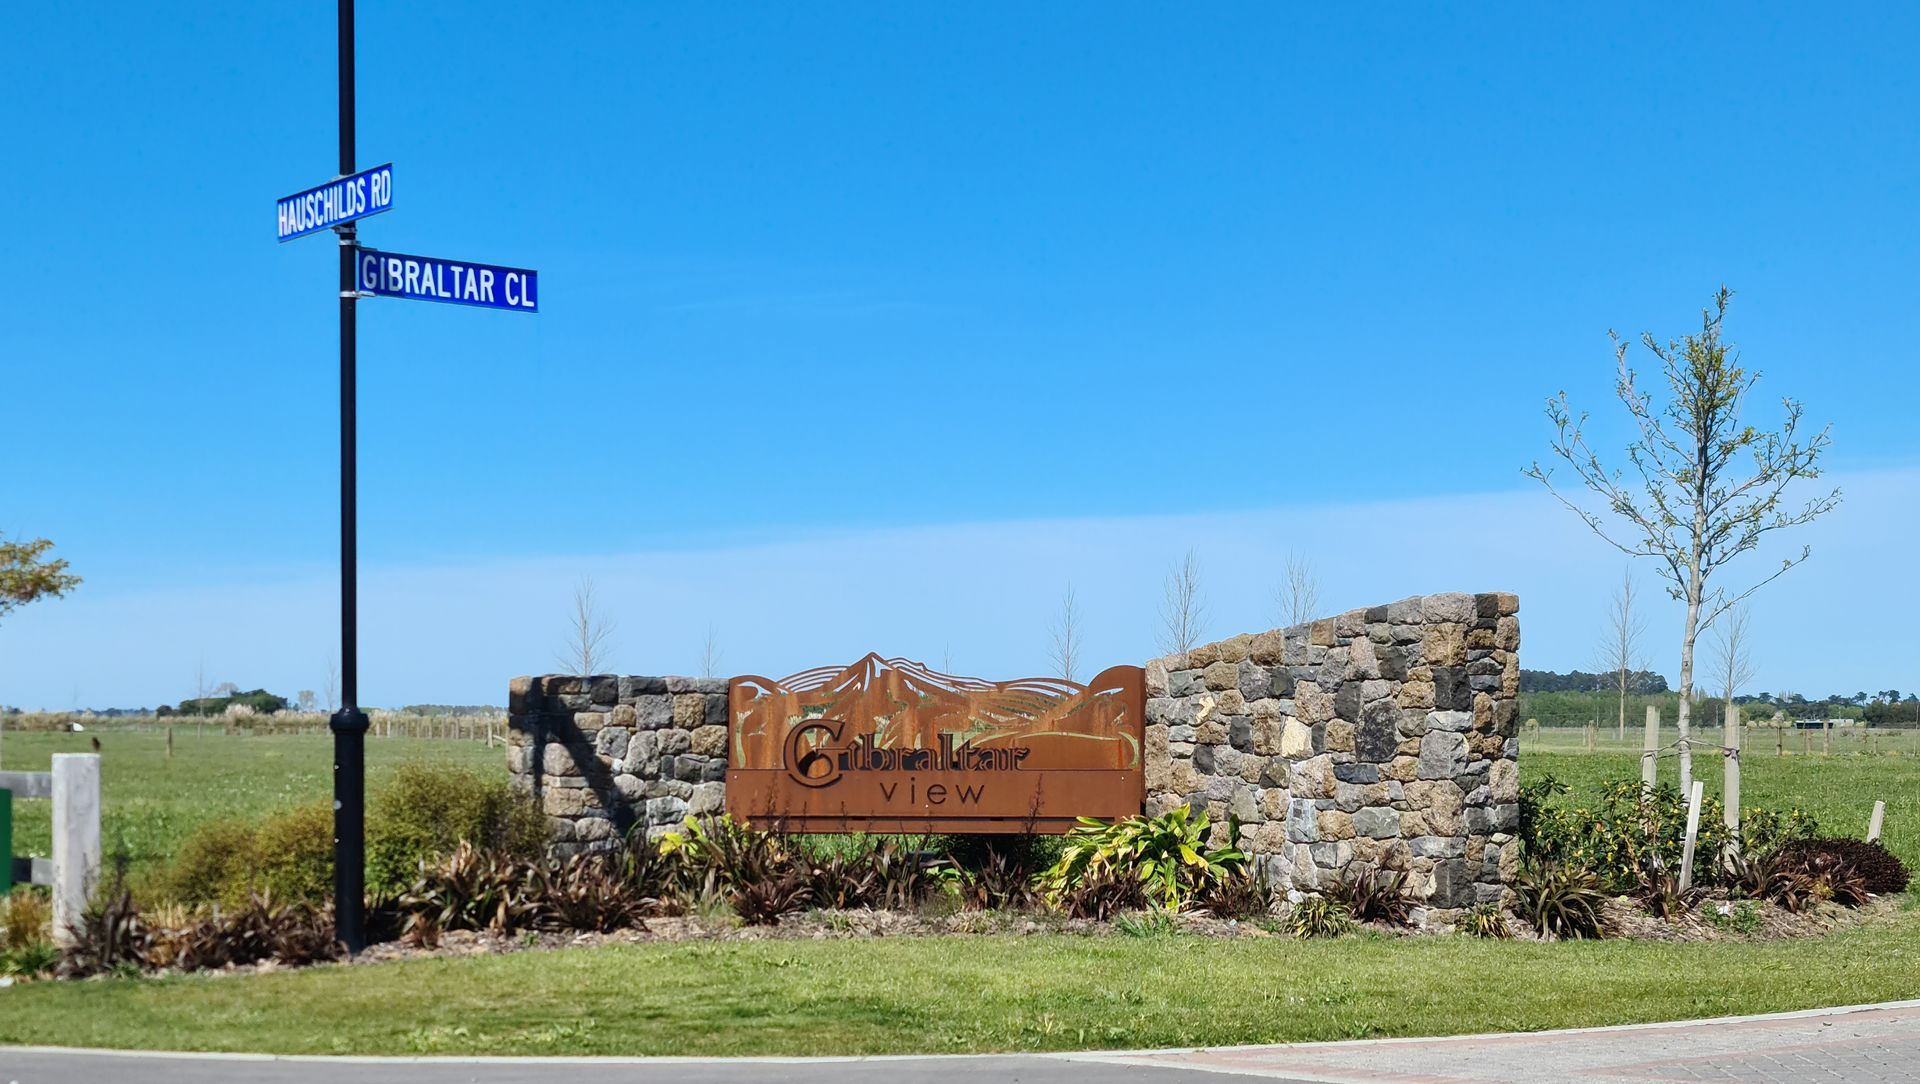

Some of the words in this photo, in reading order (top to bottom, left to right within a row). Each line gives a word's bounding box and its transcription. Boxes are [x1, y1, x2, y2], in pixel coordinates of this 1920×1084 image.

[278, 177, 366, 237] HAUSCHILDS
[371, 170, 391, 209] RD
[362, 255, 494, 303] GIBRALTAR
[505, 273, 535, 307] CL
[784, 719, 1030, 788] Gibraltar
[880, 777, 985, 804] view
